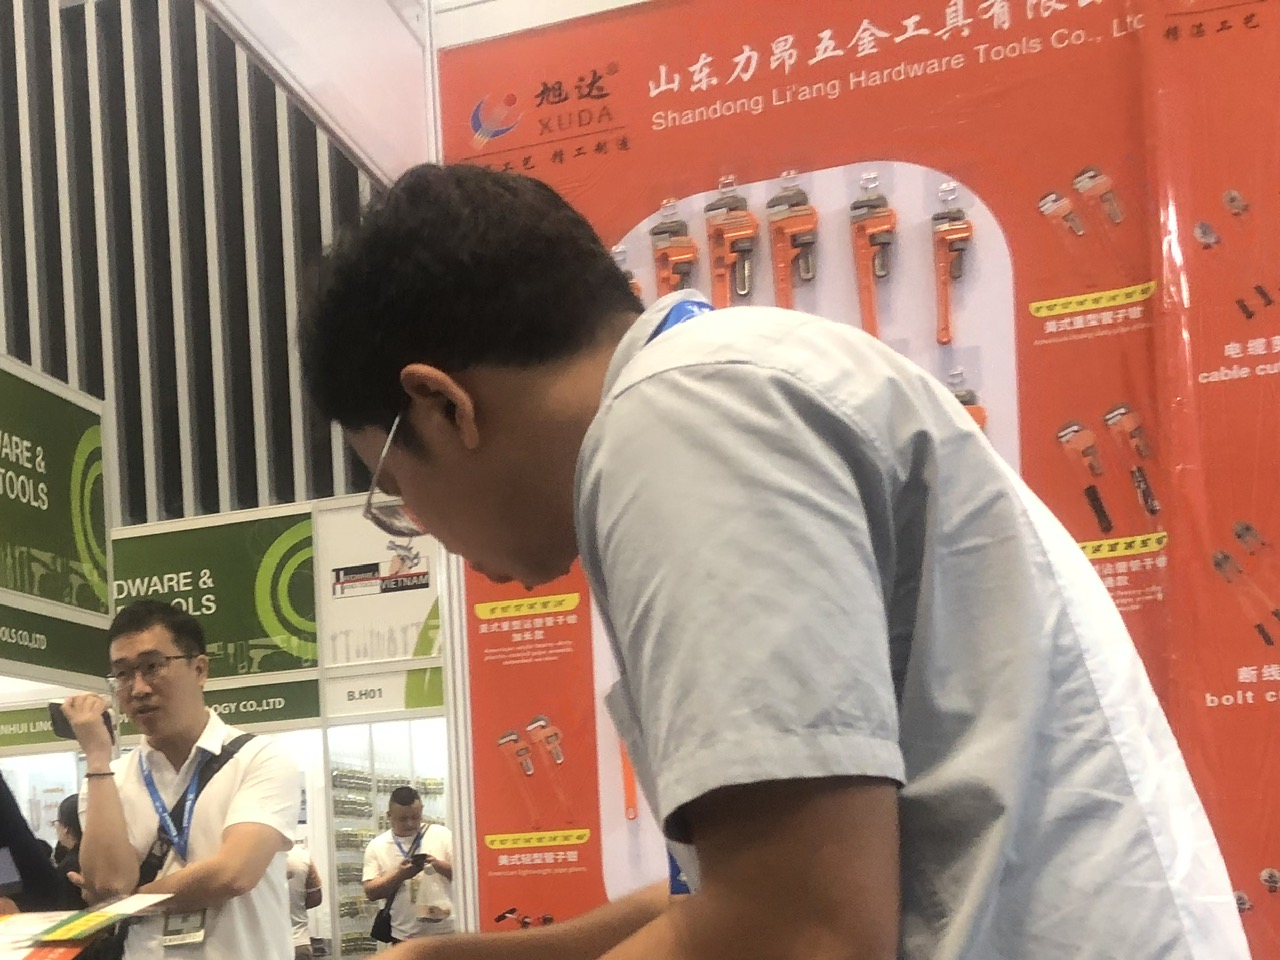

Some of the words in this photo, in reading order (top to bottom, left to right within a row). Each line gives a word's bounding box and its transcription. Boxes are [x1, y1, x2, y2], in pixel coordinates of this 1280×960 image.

[648, 0, 1105, 98] 山东力昂五金工具有限
[651, 95, 765, 132] Shandong
[771, 79, 841, 107] Li'ang
[849, 50, 966, 92] Hardware
[973, 36, 1045, 64] Tools
[538, 105, 614, 136] XUDA
[1198, 364, 1251, 384] cable
[35, 445, 48, 475] &
[198, 568, 215, 590] &
[381, 574, 430, 591] VIETNAM
[347, 687, 384, 702] B.H01
[1205, 690, 1255, 707] bolt
[206, 701, 238, 717] OGY
